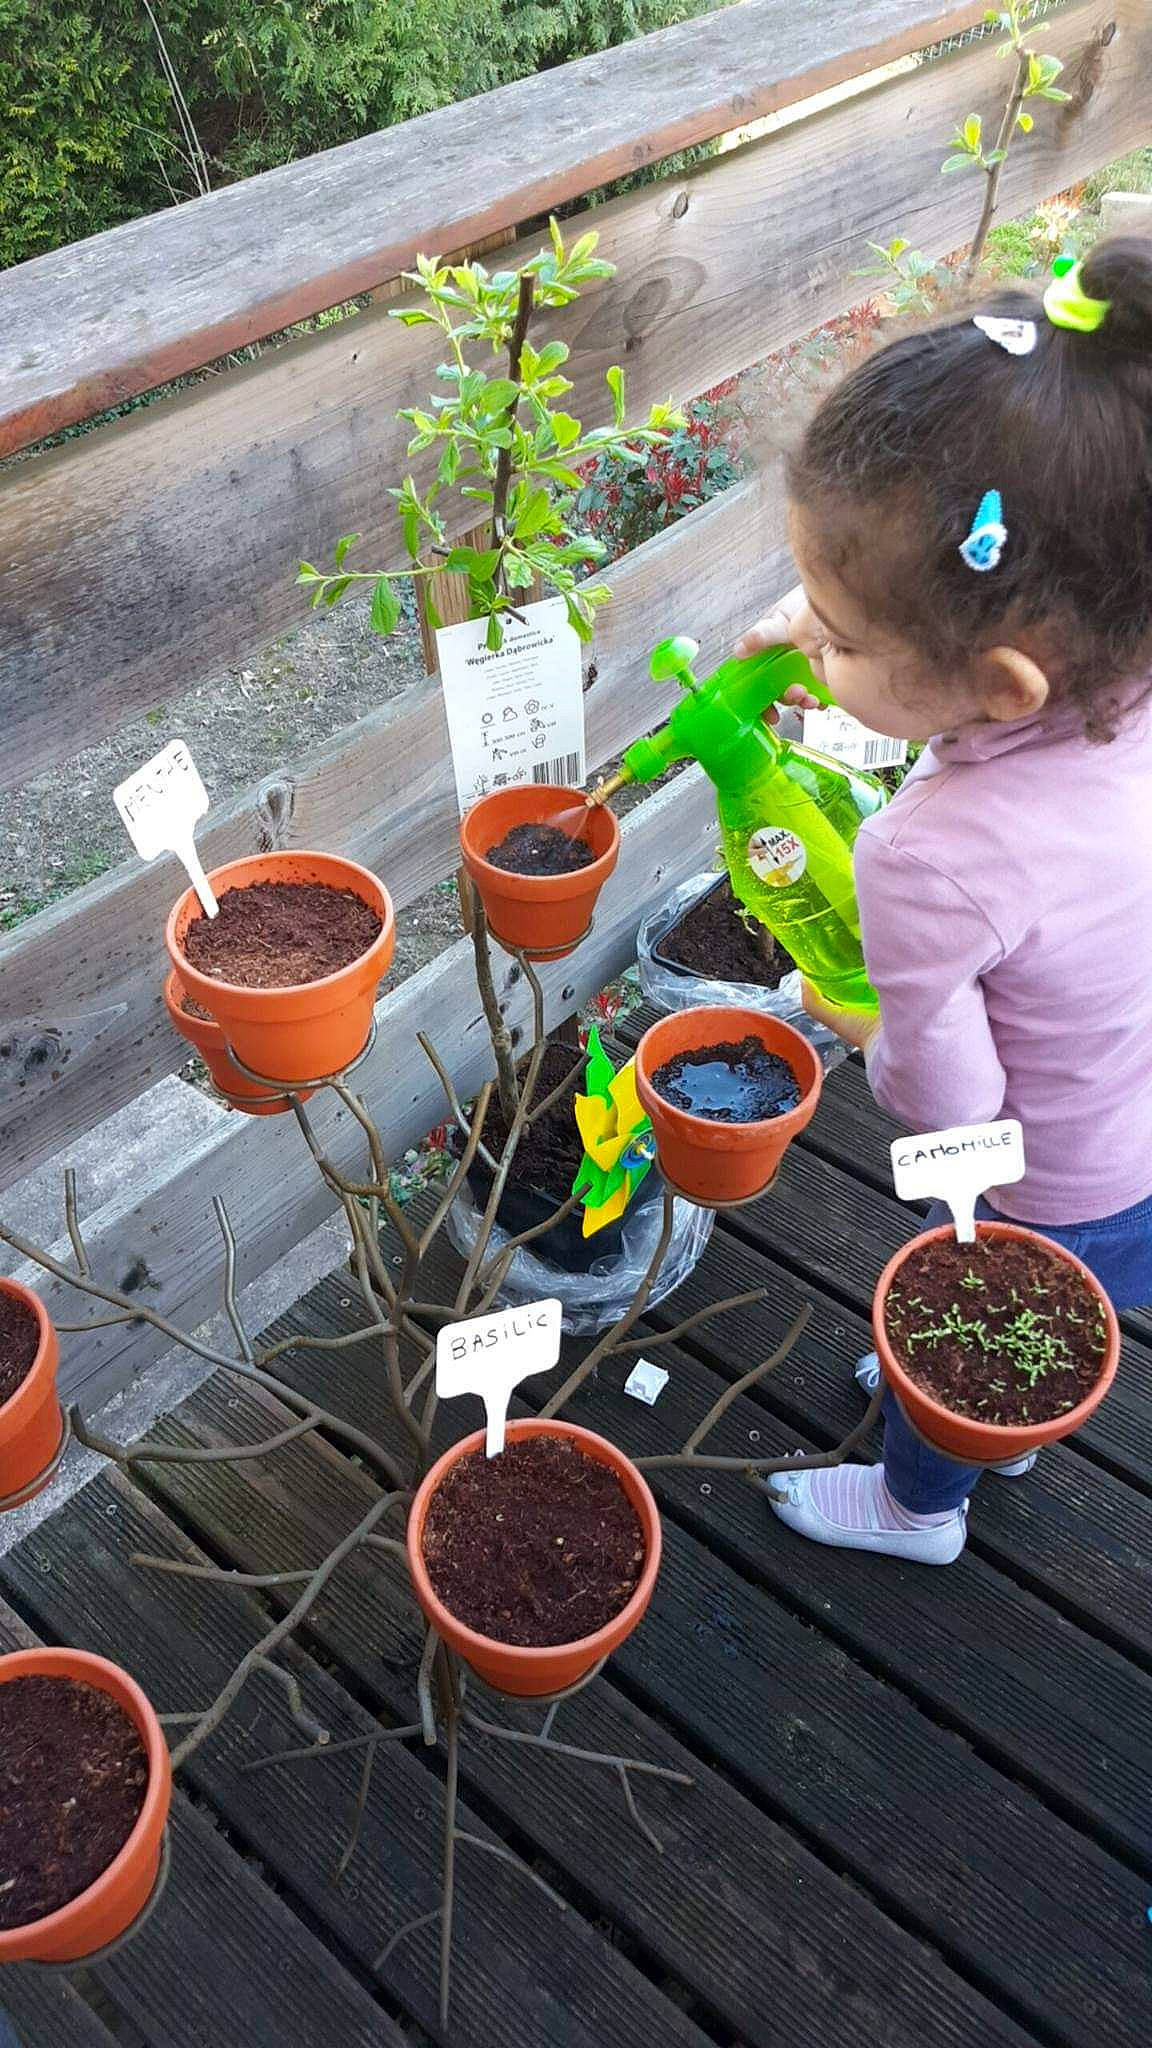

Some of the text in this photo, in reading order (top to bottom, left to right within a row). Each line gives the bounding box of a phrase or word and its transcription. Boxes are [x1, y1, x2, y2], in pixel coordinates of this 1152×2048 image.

[477, 637, 508, 651] Prs
[897, 1131, 1012, 1167] CAMOMILLE
[450, 1313, 549, 1360] BASILIC
